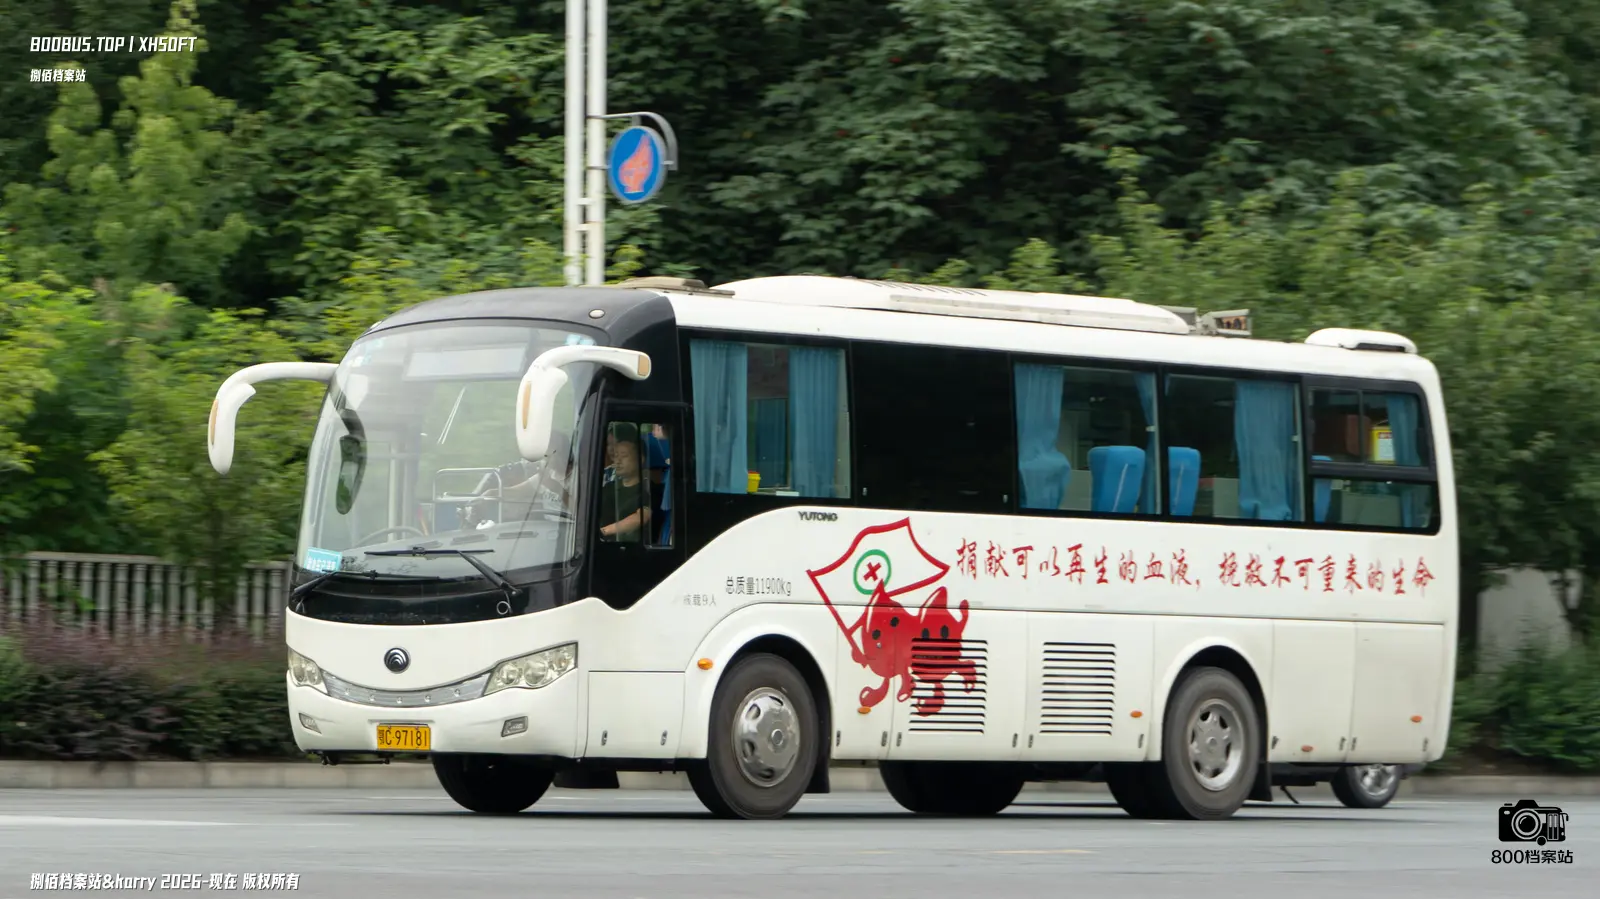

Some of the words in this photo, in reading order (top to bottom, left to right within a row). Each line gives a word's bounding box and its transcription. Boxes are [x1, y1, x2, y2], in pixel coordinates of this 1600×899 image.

[798, 511, 839, 521] YUTONG
[726, 576, 792, 596] 总质量11900kg
